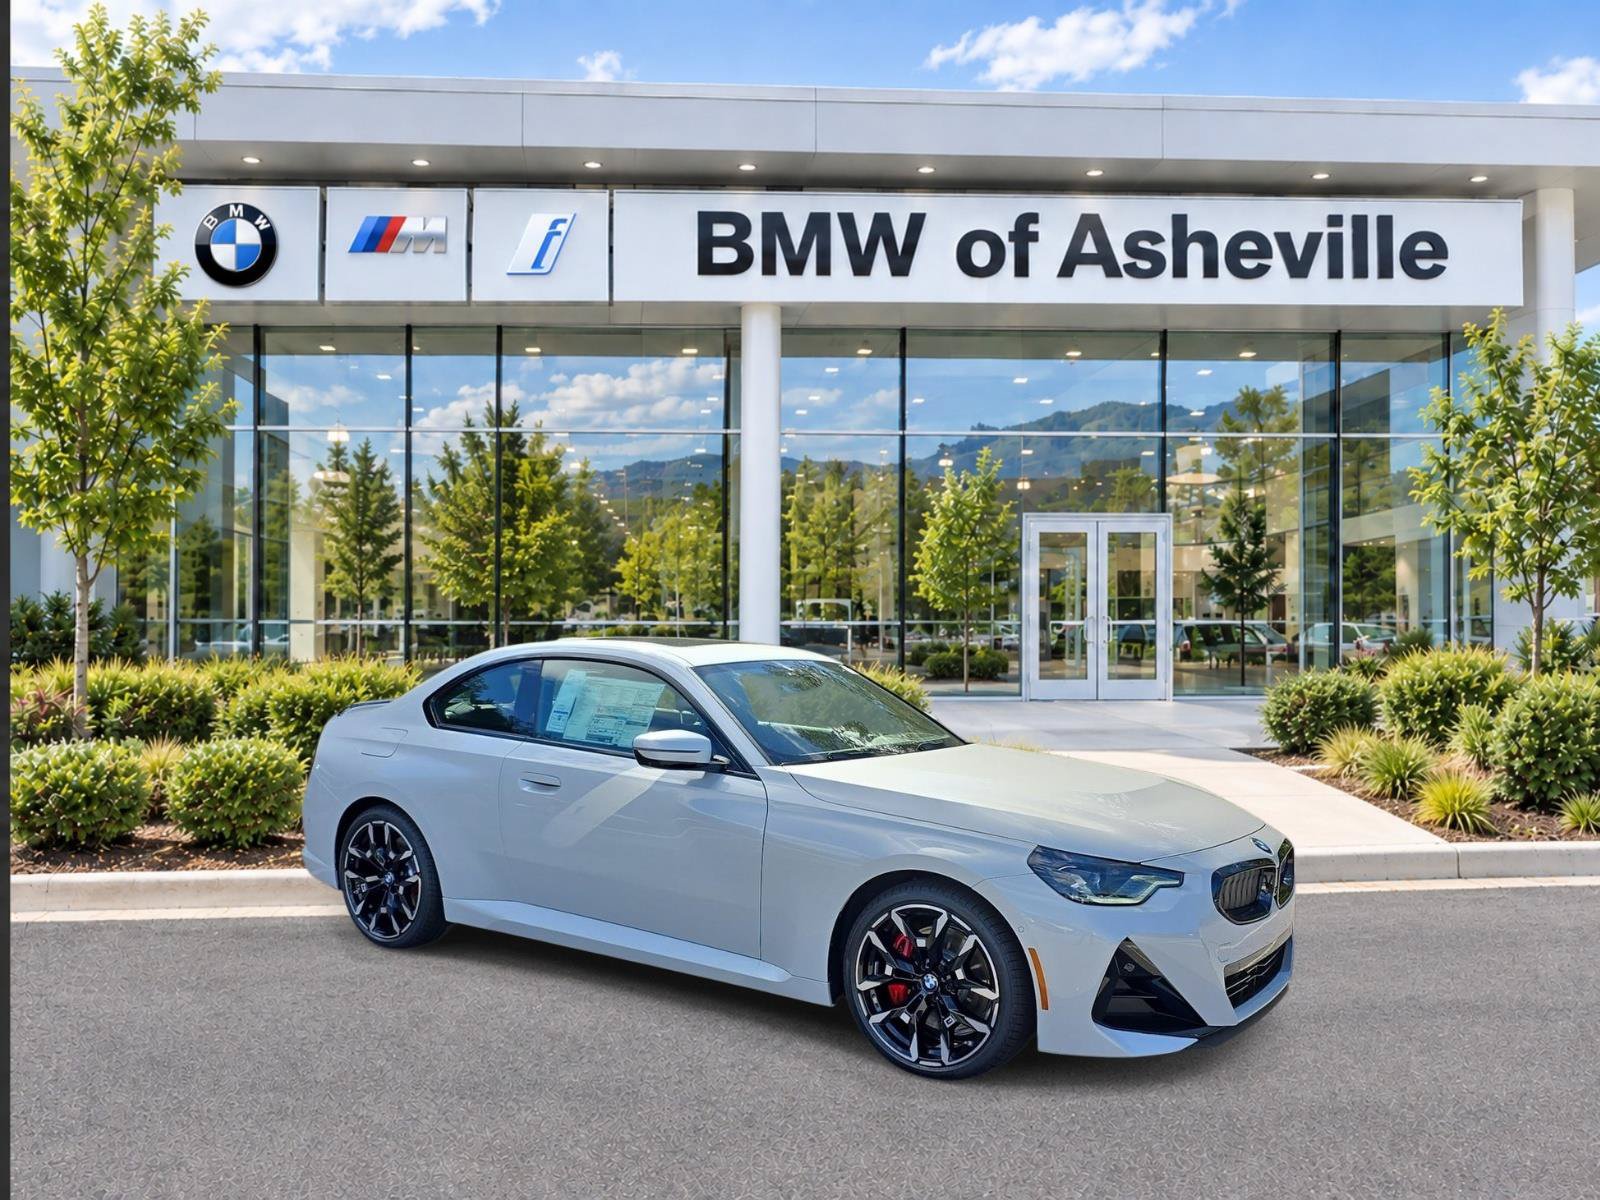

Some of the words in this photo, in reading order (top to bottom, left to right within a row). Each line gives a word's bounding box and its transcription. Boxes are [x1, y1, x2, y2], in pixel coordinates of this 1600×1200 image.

[202, 204, 271, 230] BMW
[389, 216, 447, 254] M
[697, 210, 927, 277] BMW
[956, 212, 1040, 279] of
[1056, 213, 1449, 280] Asheville
